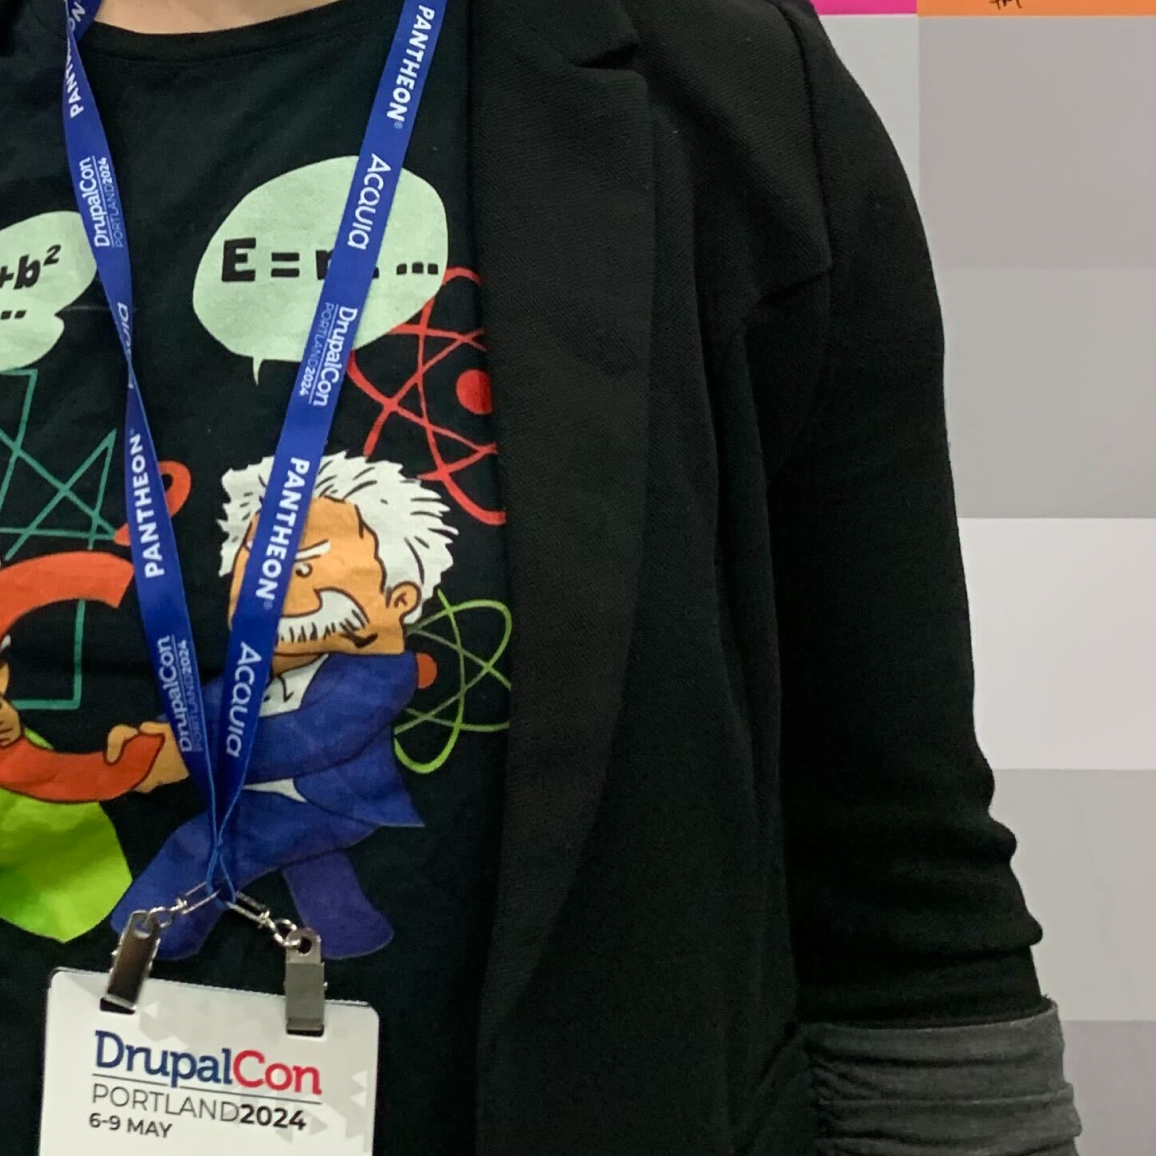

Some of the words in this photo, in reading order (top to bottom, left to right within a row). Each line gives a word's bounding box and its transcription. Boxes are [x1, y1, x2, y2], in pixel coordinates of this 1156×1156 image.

[387, 5, 435, 123] PANTHEON
[79, 157, 111, 247] DrupalCon
[314, 306, 358, 406] DrupalCon
[129, 433, 165, 579] PANTHEON
[256, 457, 310, 601] PANTHEON
[157, 636, 192, 753] DrupalCon
[92, 1083, 307, 1131] PORTLAND2024
[95, 1030, 322, 1095] DrupalCon
[89, 1112, 121, 1131] 6-9
[127, 1117, 172, 1138] MAY
